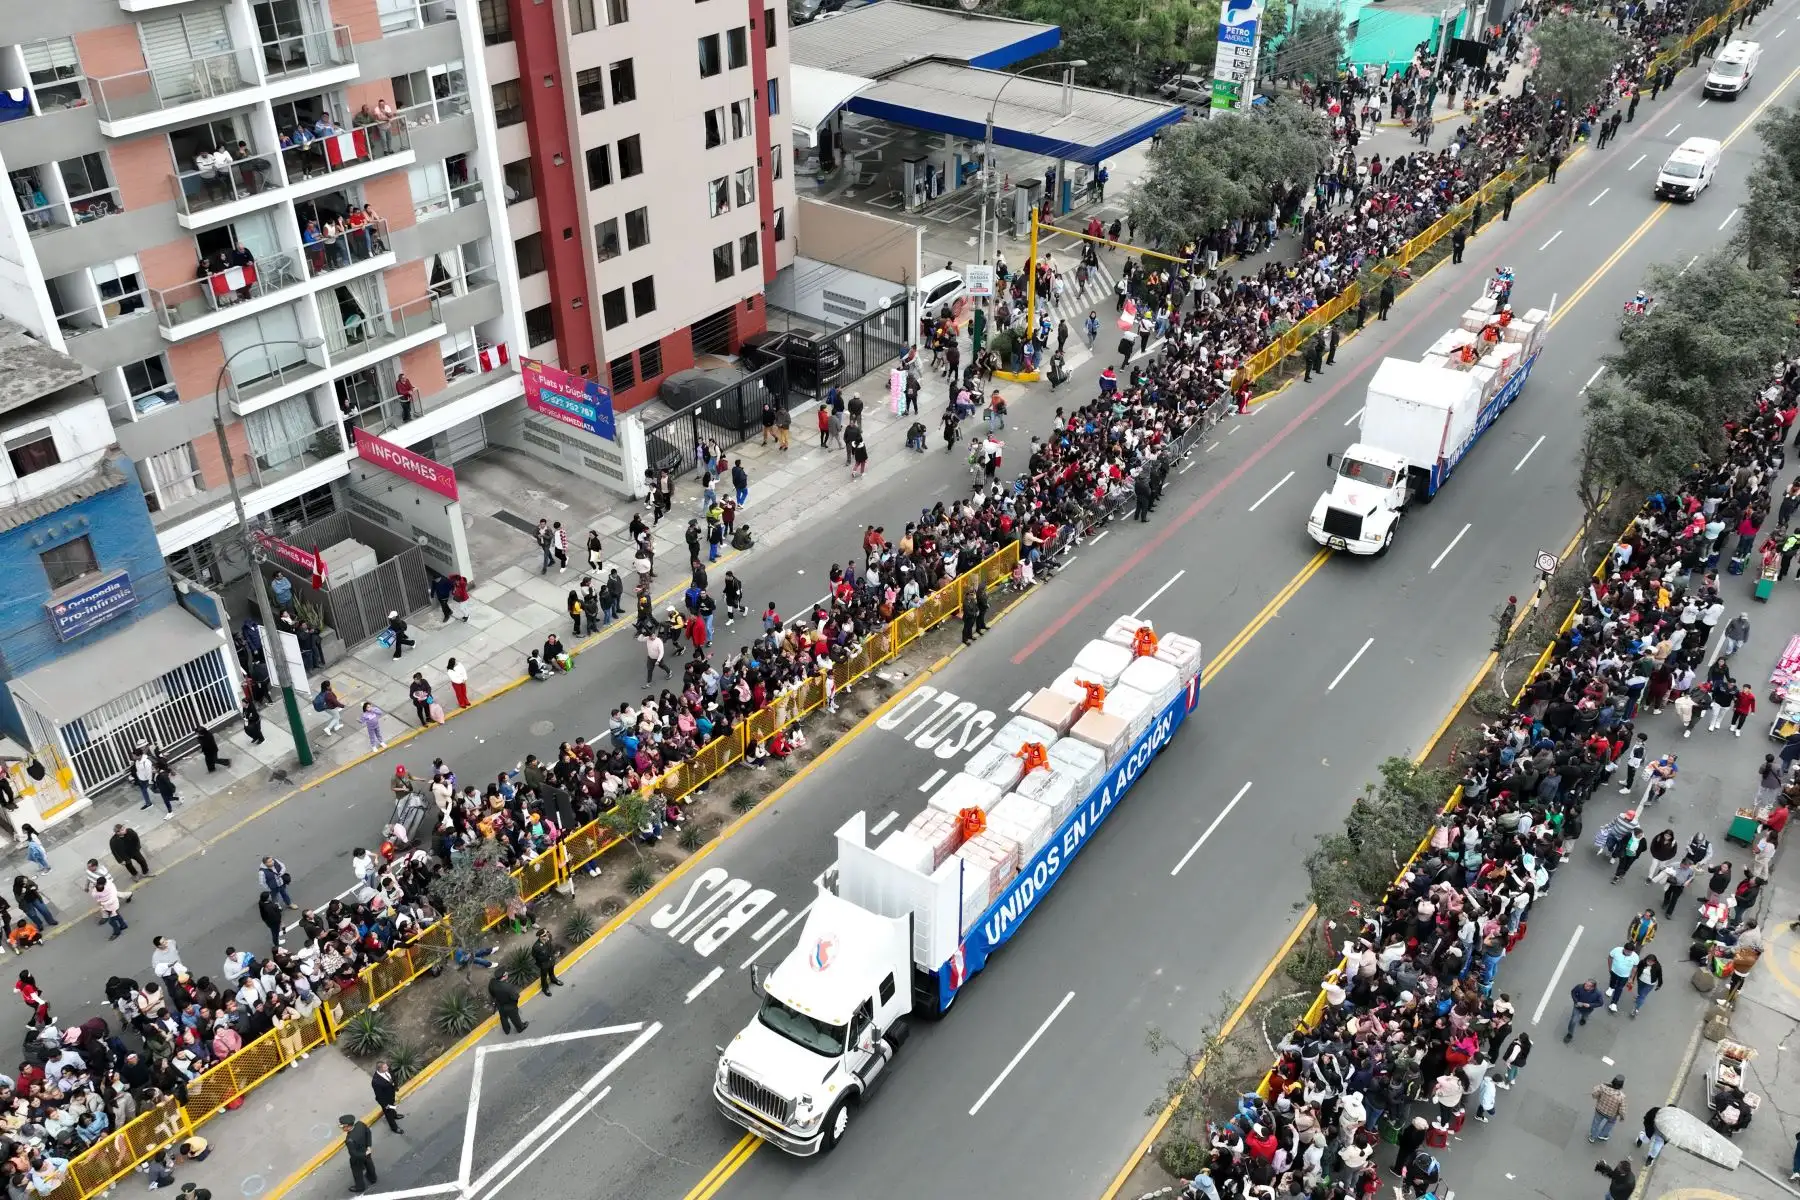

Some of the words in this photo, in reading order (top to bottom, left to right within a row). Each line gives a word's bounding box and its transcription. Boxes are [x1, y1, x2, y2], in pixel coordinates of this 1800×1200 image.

[1226, 26, 1250, 37] PETRO
[538, 374, 558, 389] Flats
[559, 384, 564, 392] y
[562, 413, 596, 433] INMEDIATA
[371, 441, 437, 482] INFORMES
[1542, 556, 1552, 566] 50
[60, 588, 132, 627] Pro-infirmis
[68, 582, 121, 610] Ortopedia
[876, 685, 997, 759] SOLO
[984, 846, 1060, 945] UNIDOS
[1063, 811, 1087, 858] EN
[1090, 785, 1112, 828] LA
[1114, 710, 1174, 797] ACCIÓN
[650, 867, 778, 958] BUS
